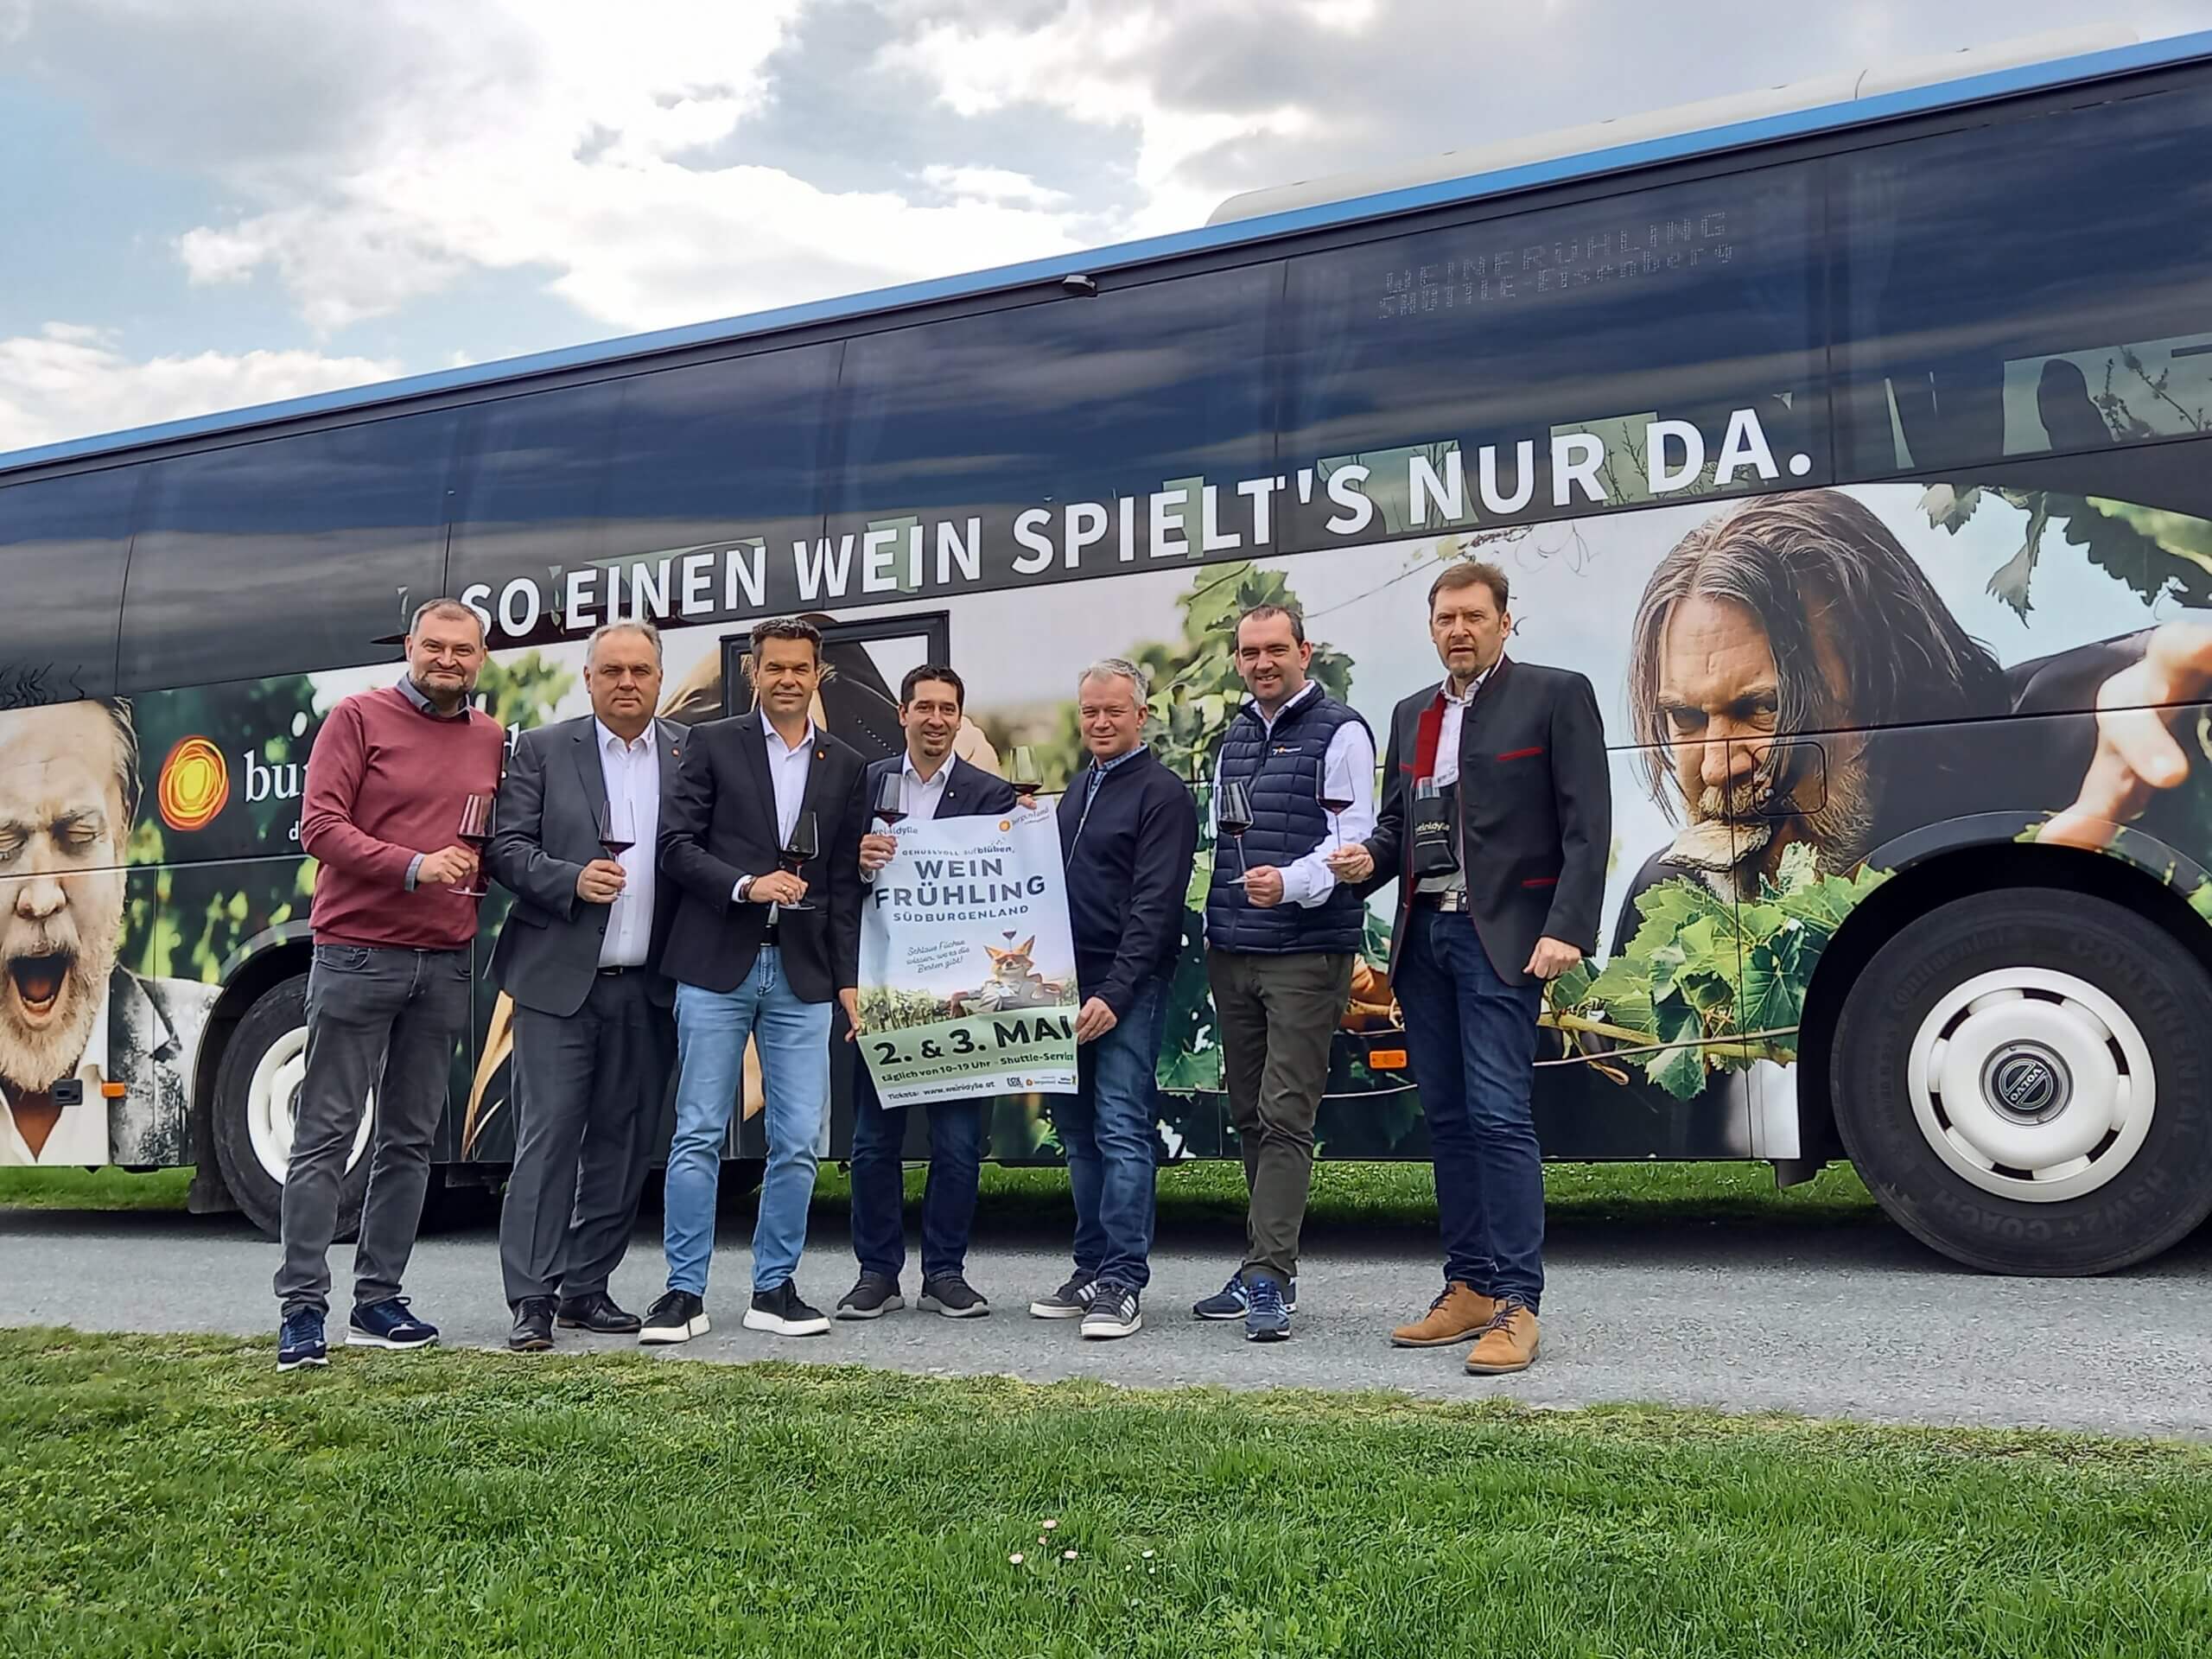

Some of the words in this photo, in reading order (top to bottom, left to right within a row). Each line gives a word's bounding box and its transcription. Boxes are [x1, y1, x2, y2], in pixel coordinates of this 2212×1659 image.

[460, 577, 541, 638] SO
[565, 545, 766, 630] EINEN
[792, 517, 982, 601] WEIN
[1010, 464, 1375, 575] SPIELT'S
[1408, 432, 1609, 525] NUR
[1645, 409, 1814, 496] DA.
[914, 858, 1003, 880] WEIN
[874, 874, 1046, 910] FRÜHLING
[893, 905, 1029, 923] SÜDBURGENLAND
[874, 1042, 912, 1065] 2.
[921, 1039, 944, 1058] &
[949, 1028, 987, 1053] 3.
[993, 1015, 1073, 1048] MAI
[881, 1071, 918, 1082] täglich
[918, 1067, 938, 1077] von
[971, 1059, 991, 1070] Uhr
[2010, 1068, 2044, 1102] VOLVO
